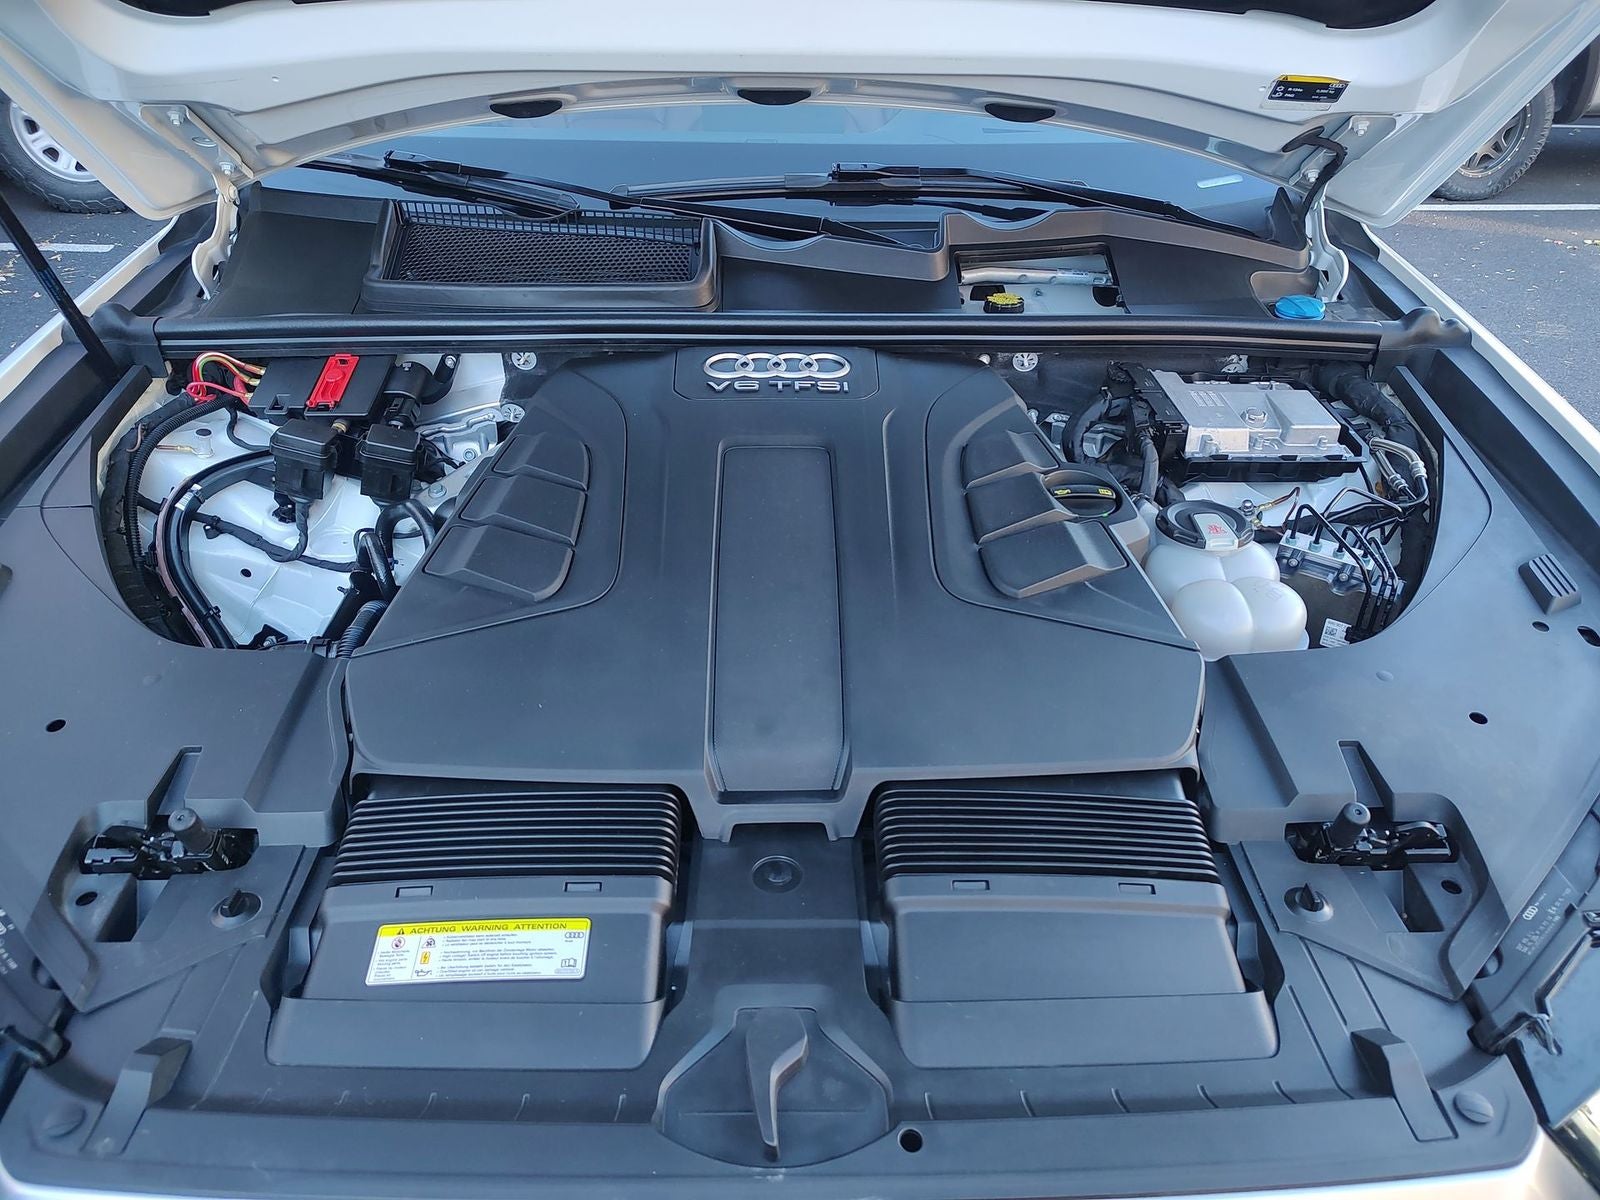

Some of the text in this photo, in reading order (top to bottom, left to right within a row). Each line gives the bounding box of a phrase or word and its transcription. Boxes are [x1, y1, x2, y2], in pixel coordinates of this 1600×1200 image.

[706, 380, 849, 393] V6 TFSI
[409, 922, 567, 935] ACHTUNG WARNING ATTENTION
